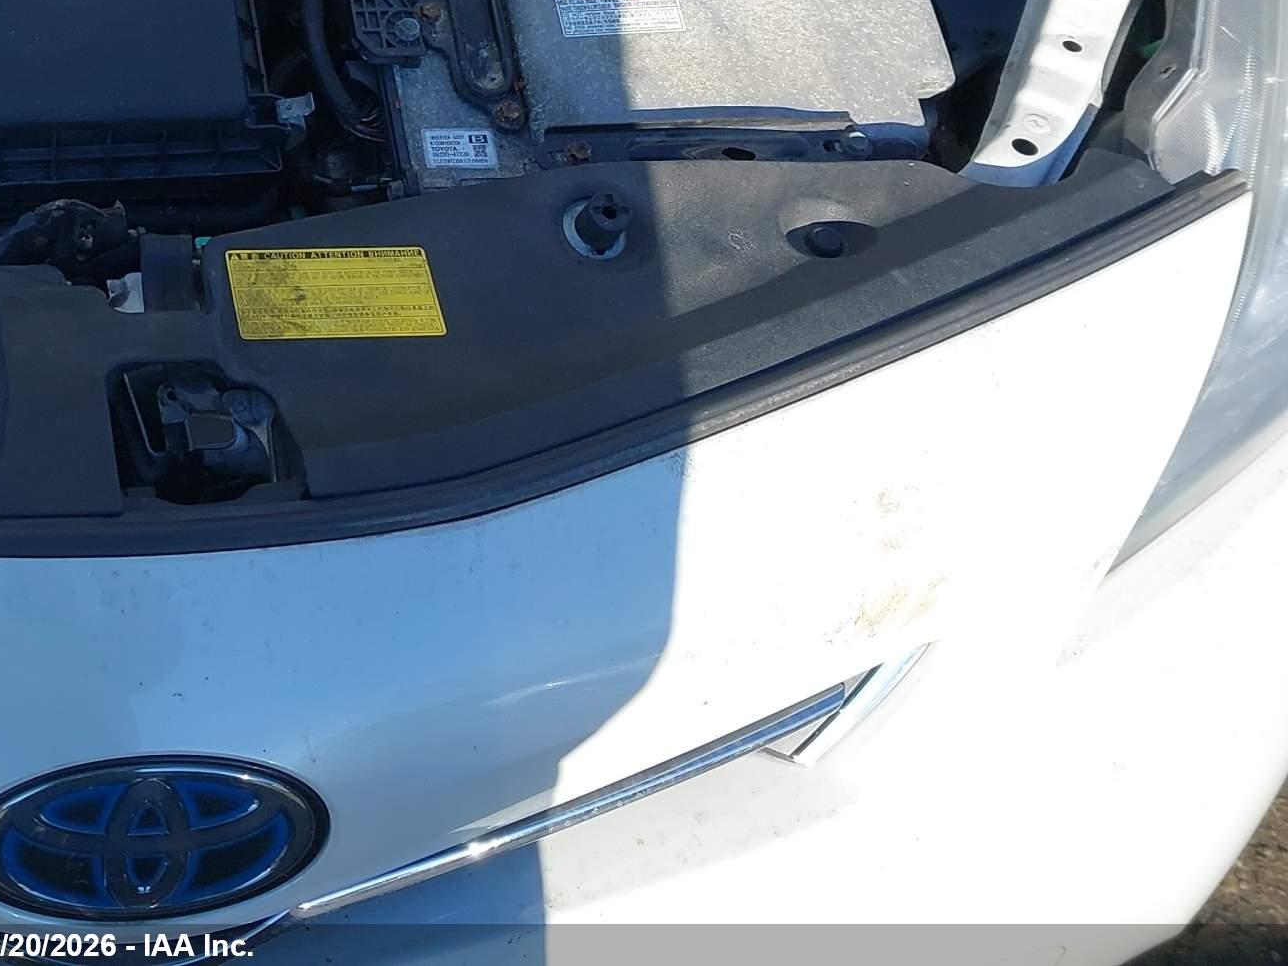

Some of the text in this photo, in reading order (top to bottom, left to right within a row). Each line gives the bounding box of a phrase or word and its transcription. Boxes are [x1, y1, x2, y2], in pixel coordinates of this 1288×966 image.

[263, 251, 306, 260] CAUTION
[310, 250, 365, 259] ATTENTION
[368, 249, 421, 259] ВНИМАНИЕ
